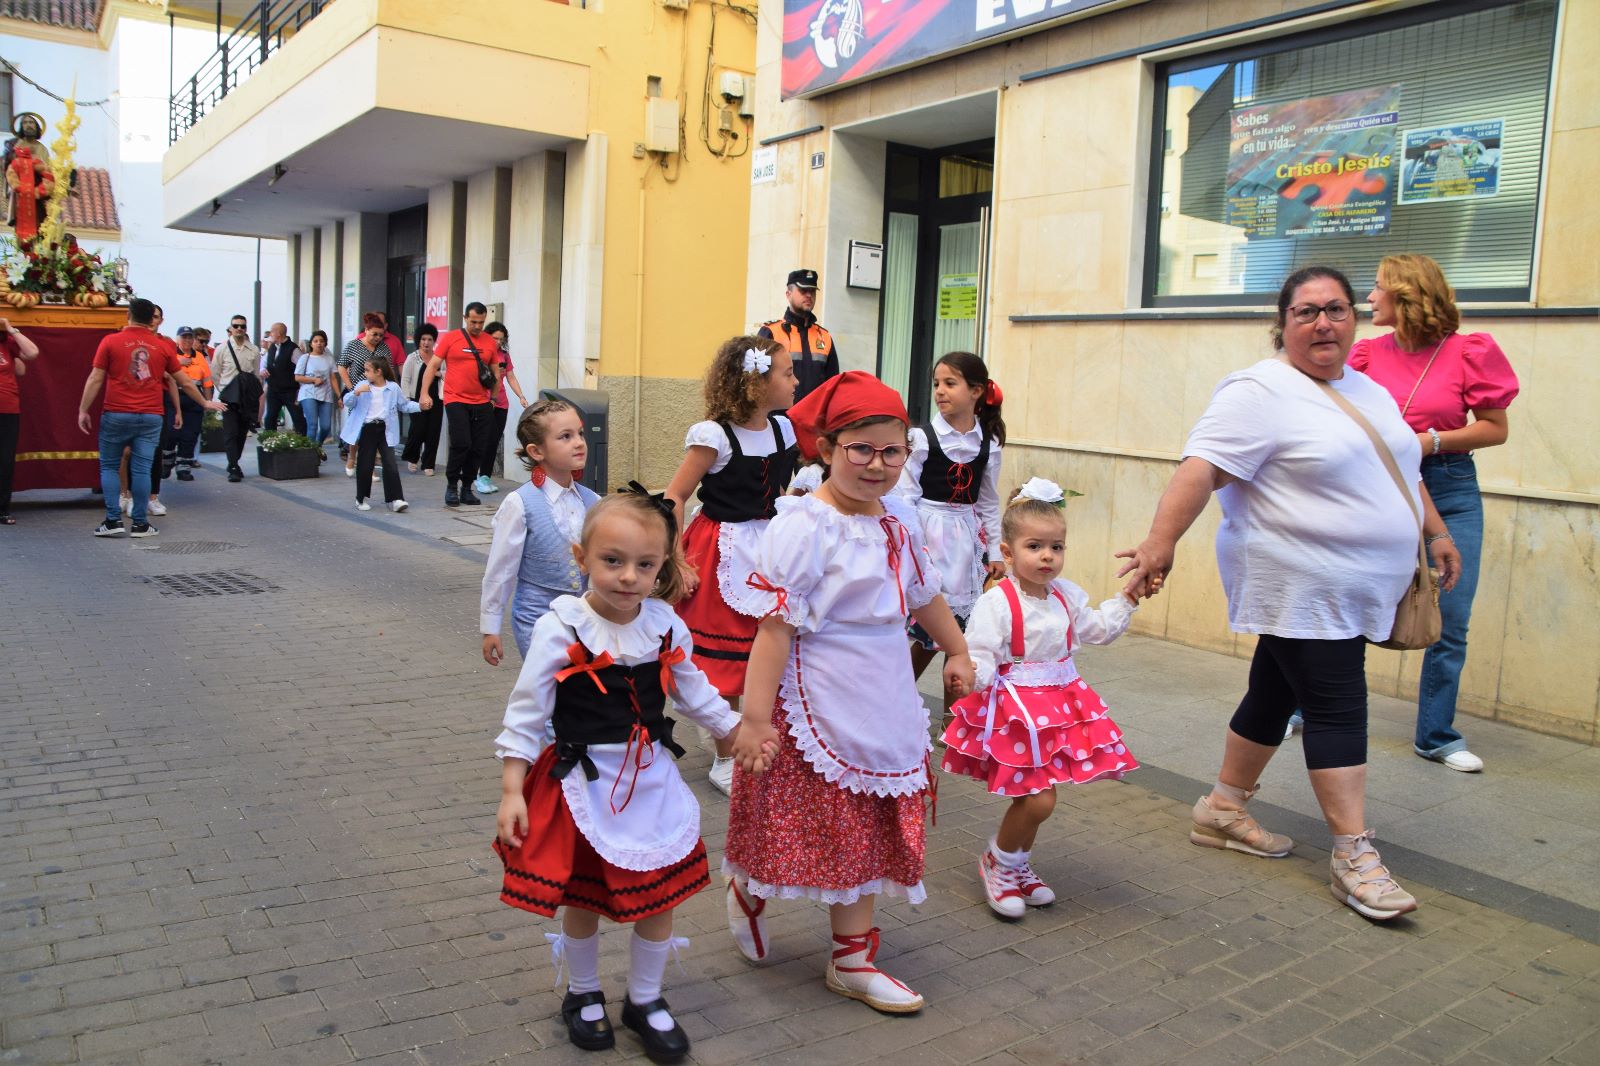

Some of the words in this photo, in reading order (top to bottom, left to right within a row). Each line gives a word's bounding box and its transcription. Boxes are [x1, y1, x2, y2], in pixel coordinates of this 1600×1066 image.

[1236, 113, 1269, 127] Sabes
[1325, 121, 1358, 132] descubre
[1359, 117, 1380, 128] Quién
[1382, 115, 1393, 125] es!
[1252, 126, 1274, 137] falta
[1275, 123, 1296, 135] algo
[1243, 142, 1254, 154] en
[1256, 140, 1267, 152] tu
[1276, 162, 1332, 179] Cristo
[1337, 152, 1392, 176] Jesús
[753, 167, 763, 179] SAN
[1354, 200, 1386, 208] Evangélica
[426, 296, 448, 317] PSOE
